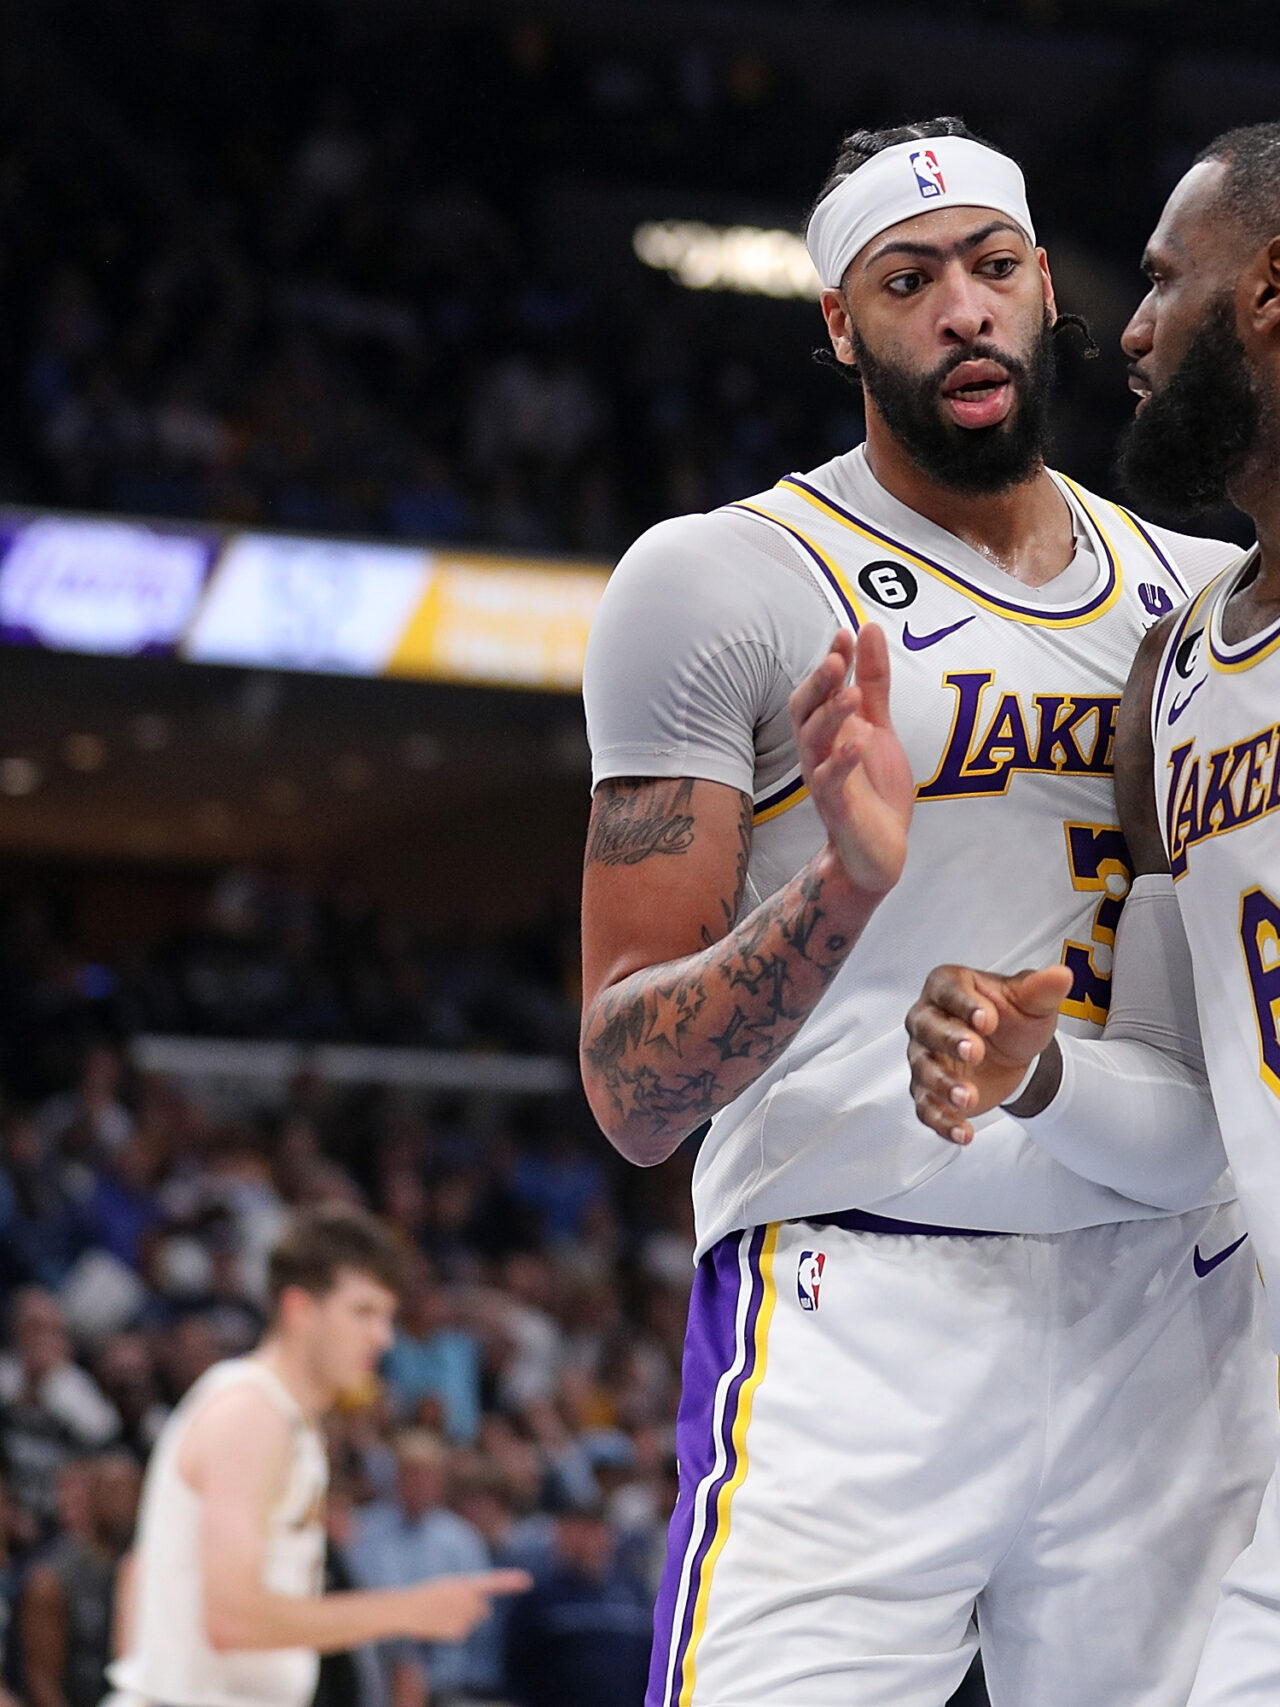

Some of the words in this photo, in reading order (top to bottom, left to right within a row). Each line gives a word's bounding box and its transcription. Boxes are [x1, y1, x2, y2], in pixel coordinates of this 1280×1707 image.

[868, 566, 908, 604] 6
[914, 668, 1123, 803] LAKE
[1058, 820, 1134, 1026] 3
